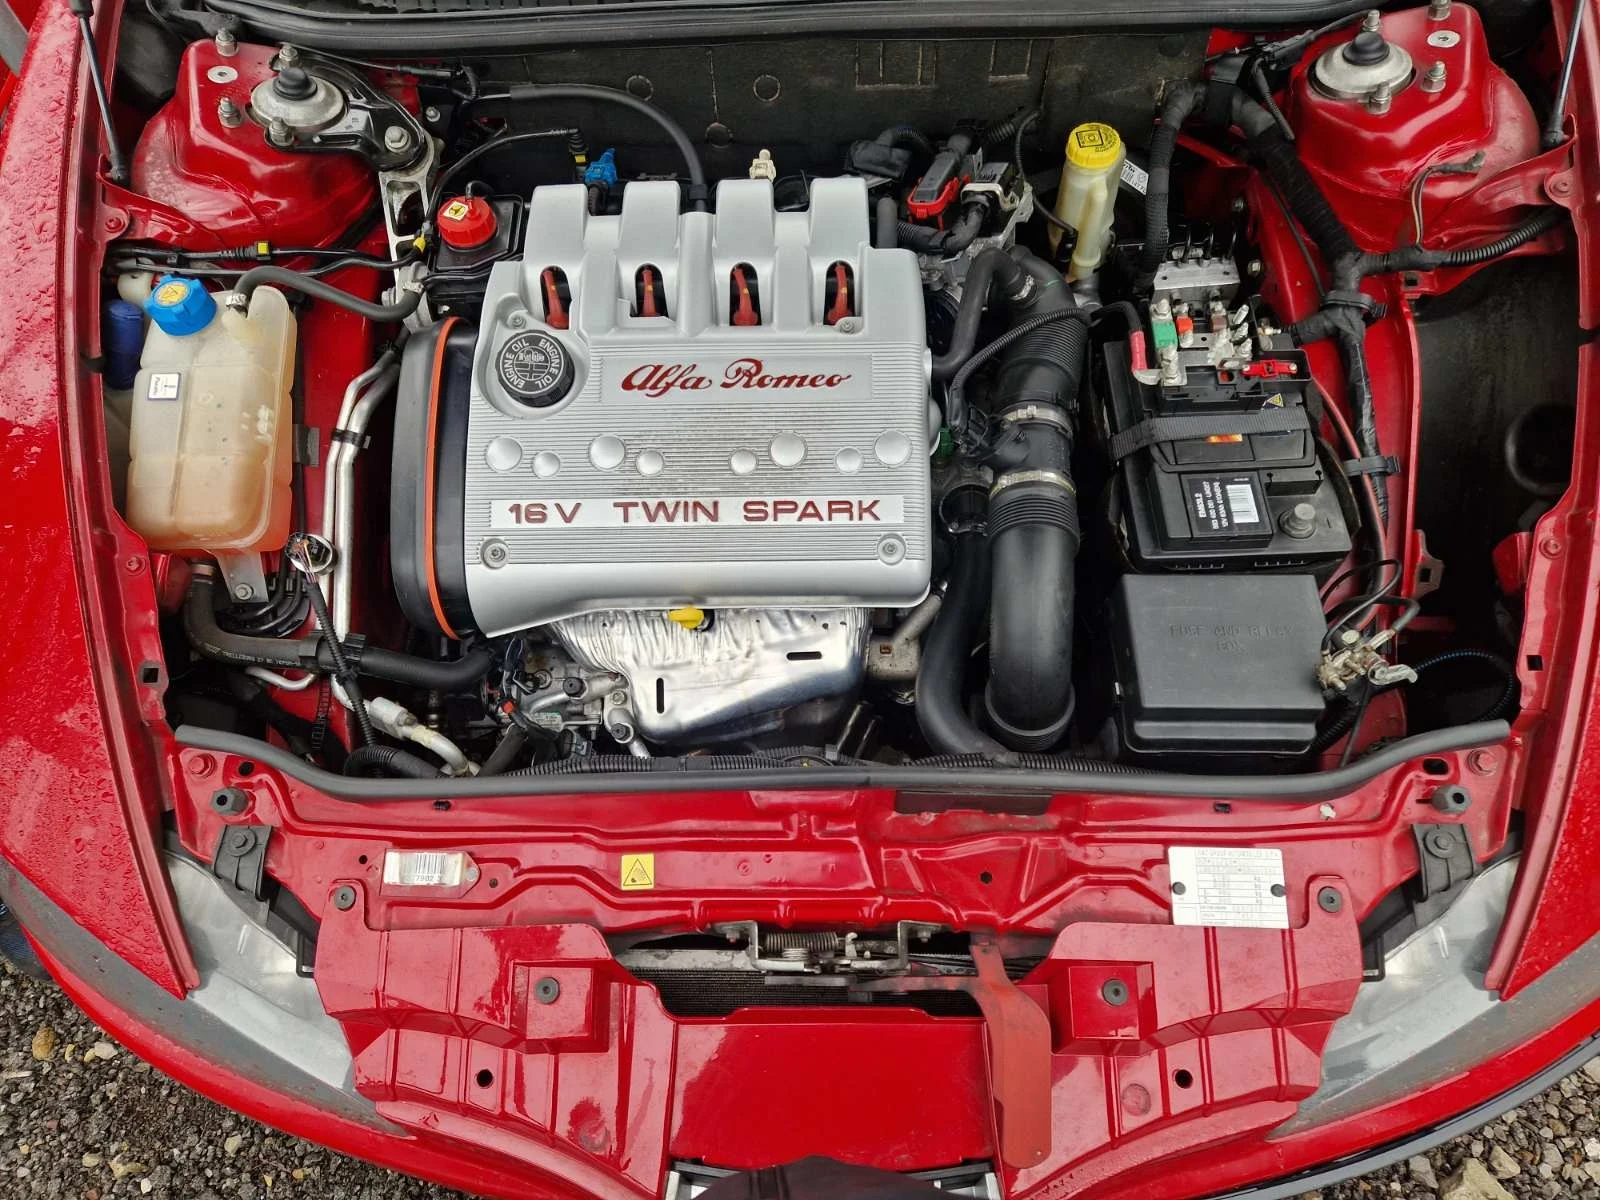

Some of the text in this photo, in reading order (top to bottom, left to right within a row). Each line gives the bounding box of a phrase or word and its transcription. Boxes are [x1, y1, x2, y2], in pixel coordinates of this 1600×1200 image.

[503, 338, 530, 389] ENGINE OIL
[535, 338, 560, 389] ENGINE OIL
[621, 357, 852, 398] Alfa Romeo
[613, 500, 720, 523] TWIN
[743, 499, 881, 522] SPARK
